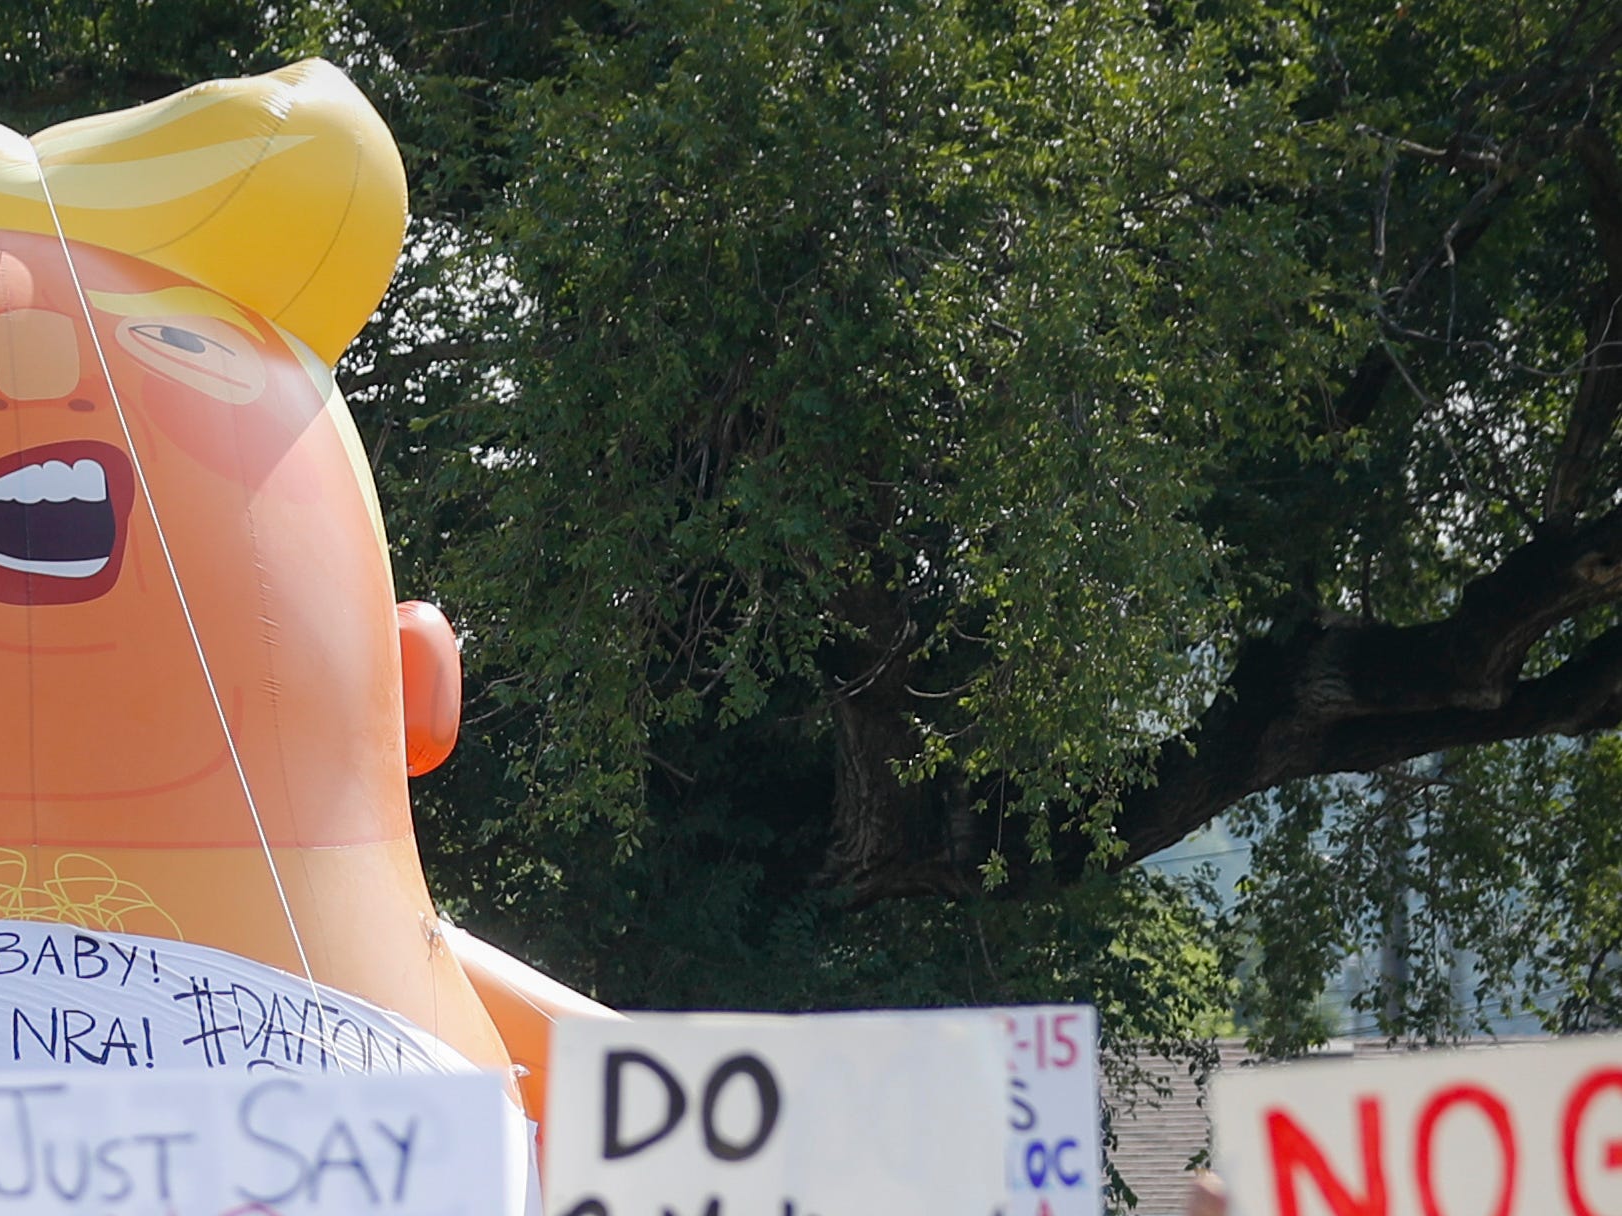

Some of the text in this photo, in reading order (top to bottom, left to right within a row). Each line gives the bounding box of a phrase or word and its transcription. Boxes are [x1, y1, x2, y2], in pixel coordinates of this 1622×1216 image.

[13, 1007, 156, 1070] NRA!
[173, 975, 404, 1077] #DAYTON
[1005, 1012, 1081, 1070] -15
[602, 1048, 783, 1162] DO
